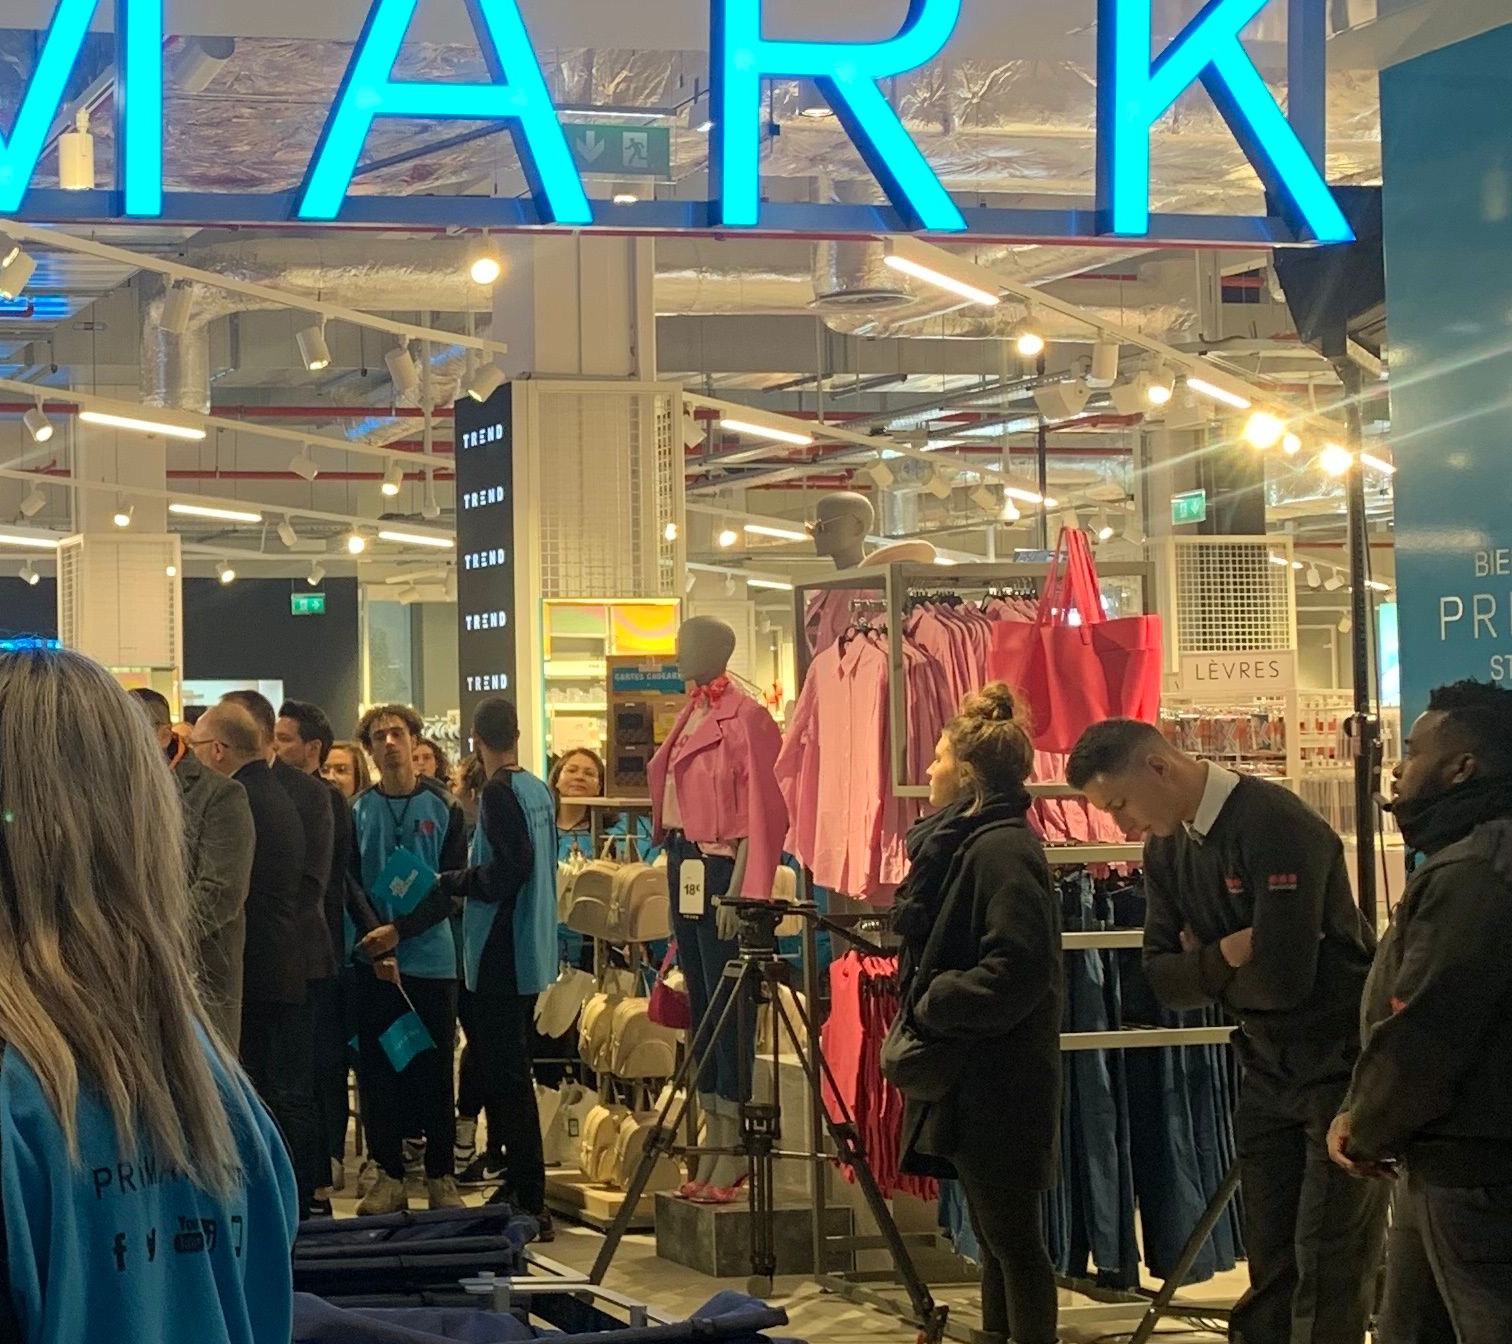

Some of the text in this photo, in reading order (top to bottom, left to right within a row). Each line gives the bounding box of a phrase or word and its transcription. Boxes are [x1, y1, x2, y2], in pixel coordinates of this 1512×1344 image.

[462, 423, 503, 449] TREND
[463, 485, 504, 509] TREND
[464, 548, 505, 570] TREND
[465, 610, 507, 631] TREND
[1195, 659, 1280, 681] LÈVRES
[466, 673, 508, 692] TREND
